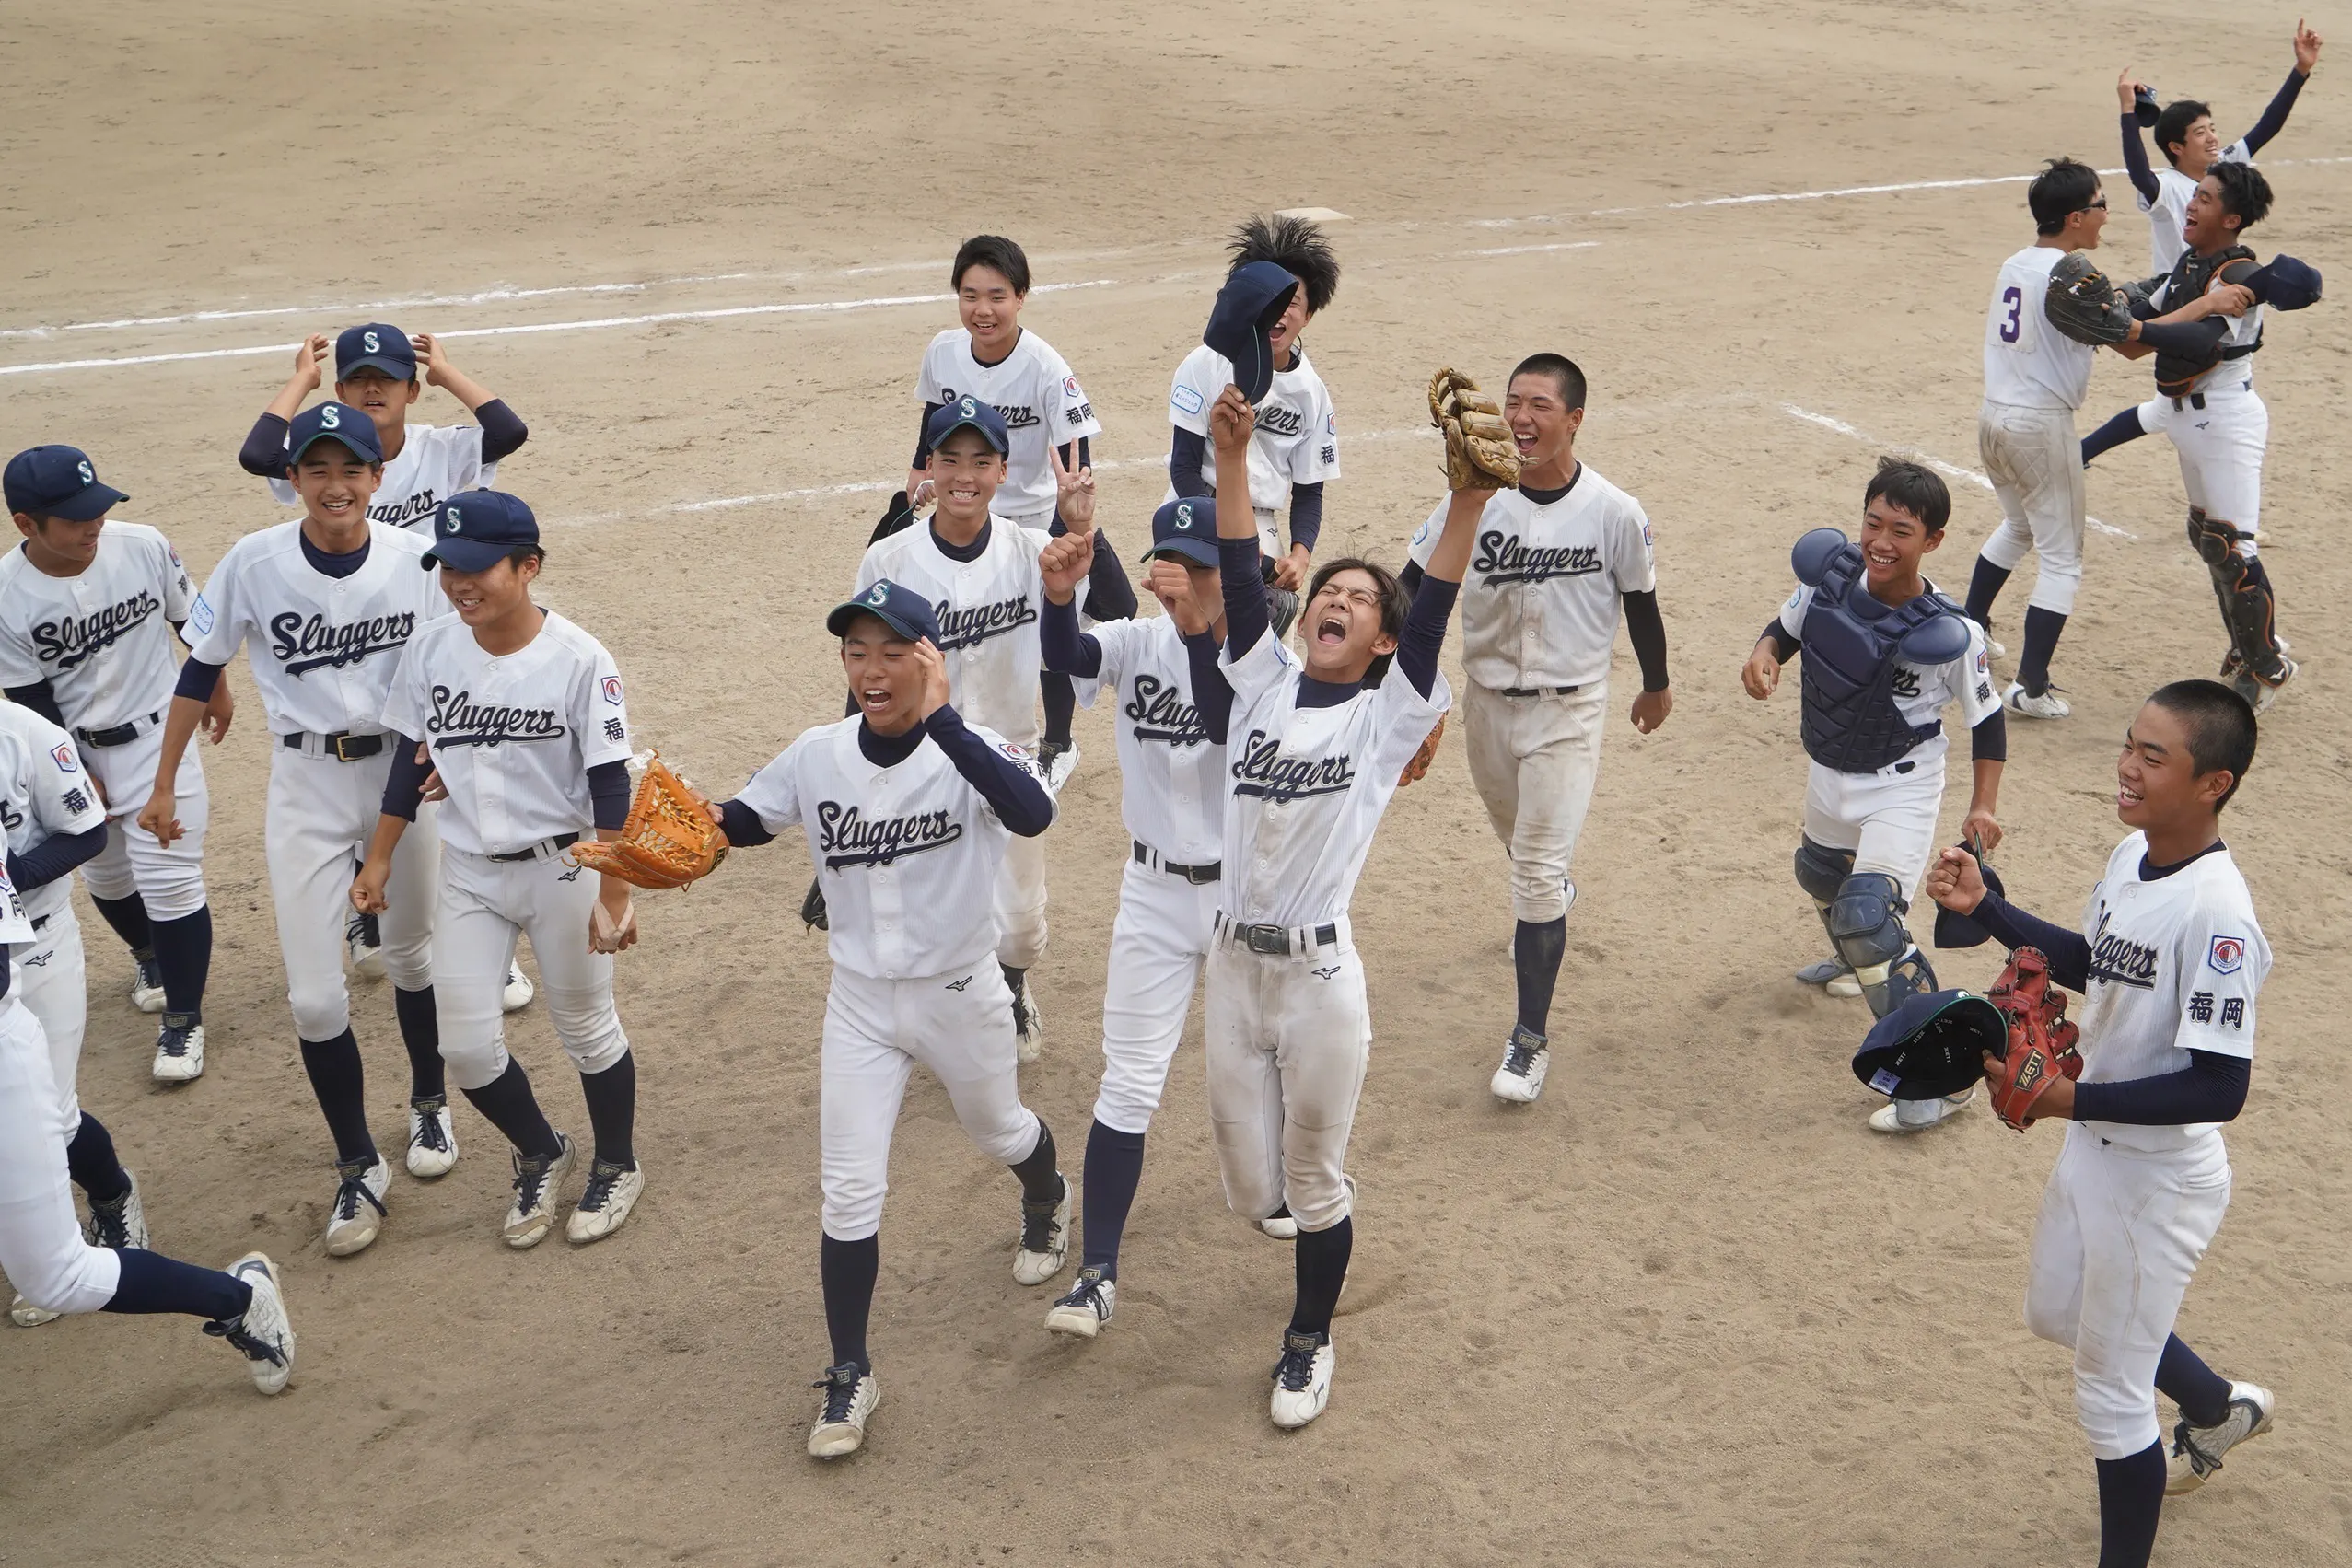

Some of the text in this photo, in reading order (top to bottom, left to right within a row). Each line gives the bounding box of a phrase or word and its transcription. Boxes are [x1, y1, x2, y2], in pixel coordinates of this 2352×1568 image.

[2000, 286, 2021, 343] 3
[363, 331, 381, 354] S
[320, 405, 341, 430] S
[961, 398, 976, 419] S
[78, 461, 93, 486] S
[447, 507, 461, 533] S
[1175, 505, 1193, 529] S
[1473, 530, 1602, 592] Sluggers
[868, 582, 889, 605] S
[32, 589, 159, 668] Sluggers
[935, 596, 1037, 651] luggers
[271, 610, 416, 678] Sluggers
[426, 685, 565, 750] Sluggers
[817, 801, 962, 868] Sluggers
[2188, 991, 2245, 1029] 福岡
[2018, 1051, 2042, 1087] ZETT
